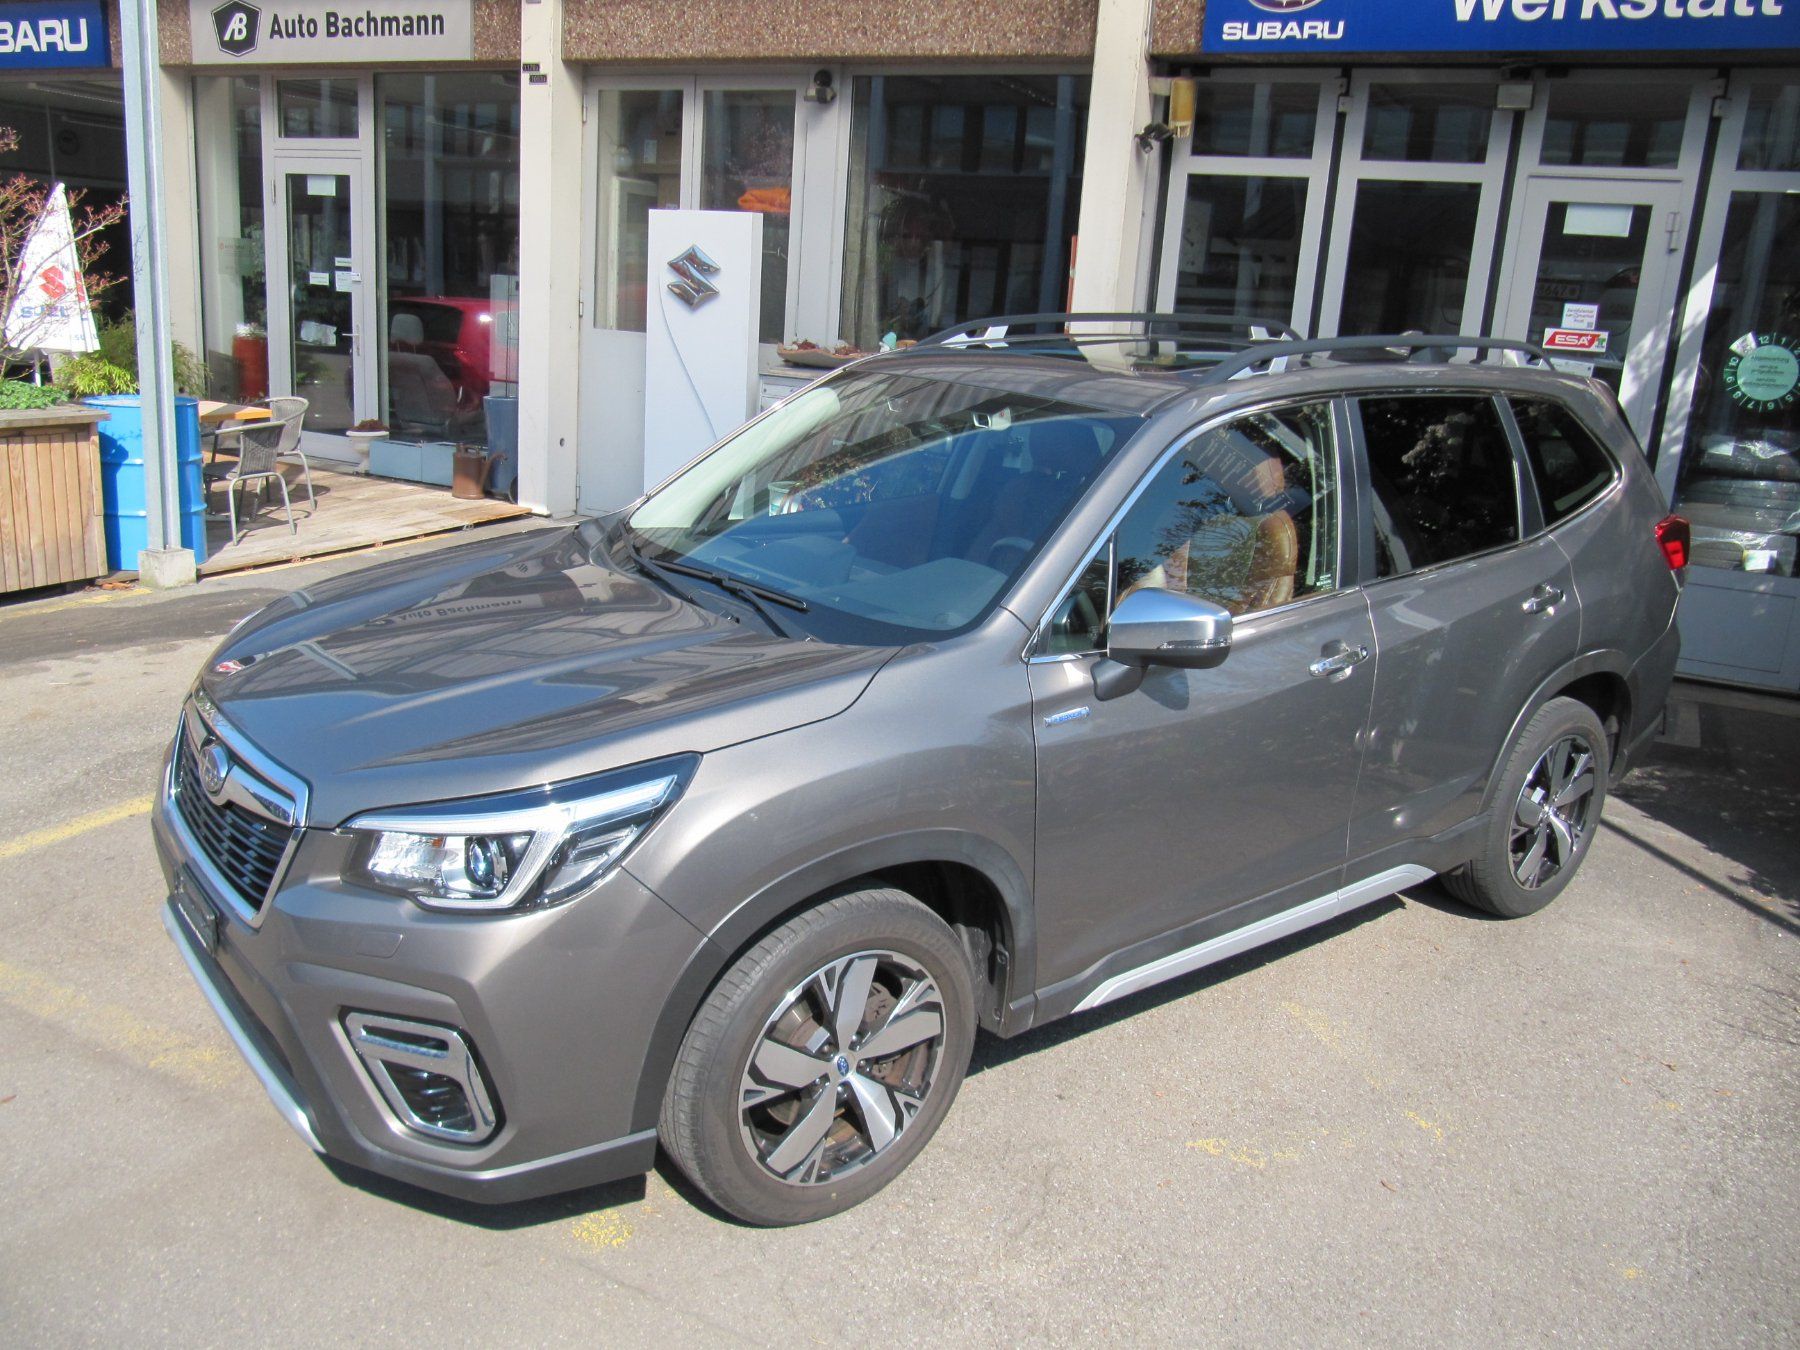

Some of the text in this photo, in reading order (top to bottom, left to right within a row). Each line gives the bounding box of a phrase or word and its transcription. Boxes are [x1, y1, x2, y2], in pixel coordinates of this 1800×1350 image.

[269, 10, 445, 40] Auto Bachmann
[1222, 21, 1345, 40] SUBARU
[1758, 336, 1769, 344] 12
